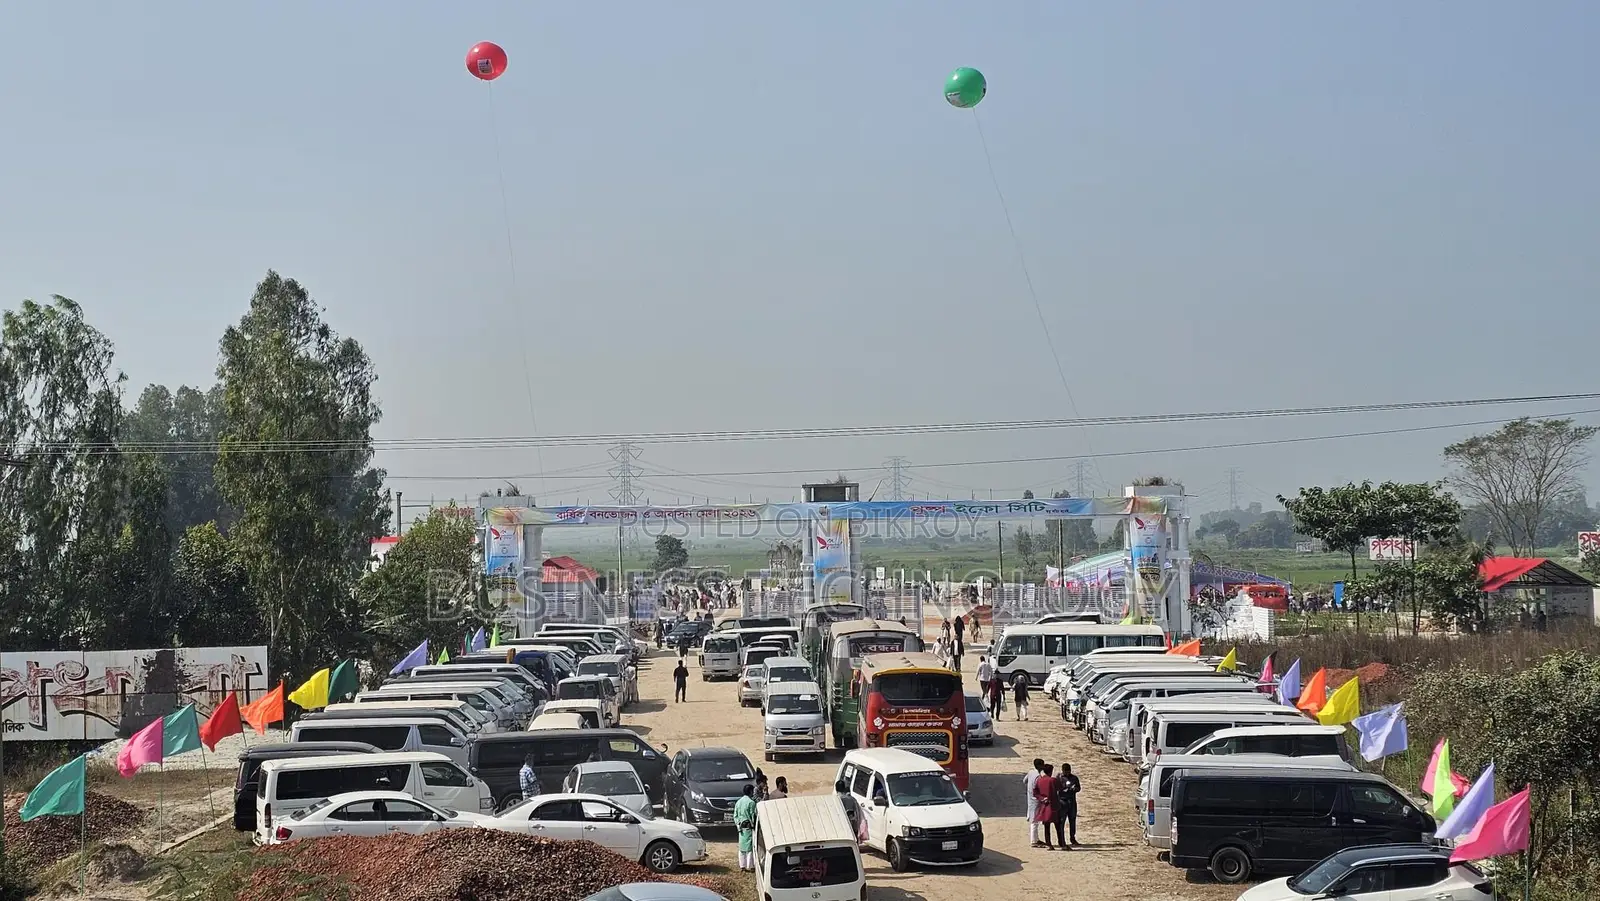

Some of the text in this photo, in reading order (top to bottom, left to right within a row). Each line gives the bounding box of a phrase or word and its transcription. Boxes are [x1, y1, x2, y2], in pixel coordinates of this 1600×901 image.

[556, 508, 756, 520] বার্ষিক বনভোজন ও আবাসন মেলা ২০২৬
[909, 505, 946, 516] পুষ্প
[953, 502, 1000, 514] ইকো
[1008, 502, 1048, 513] সিটি
[2, 719, 25, 733] ালিক
